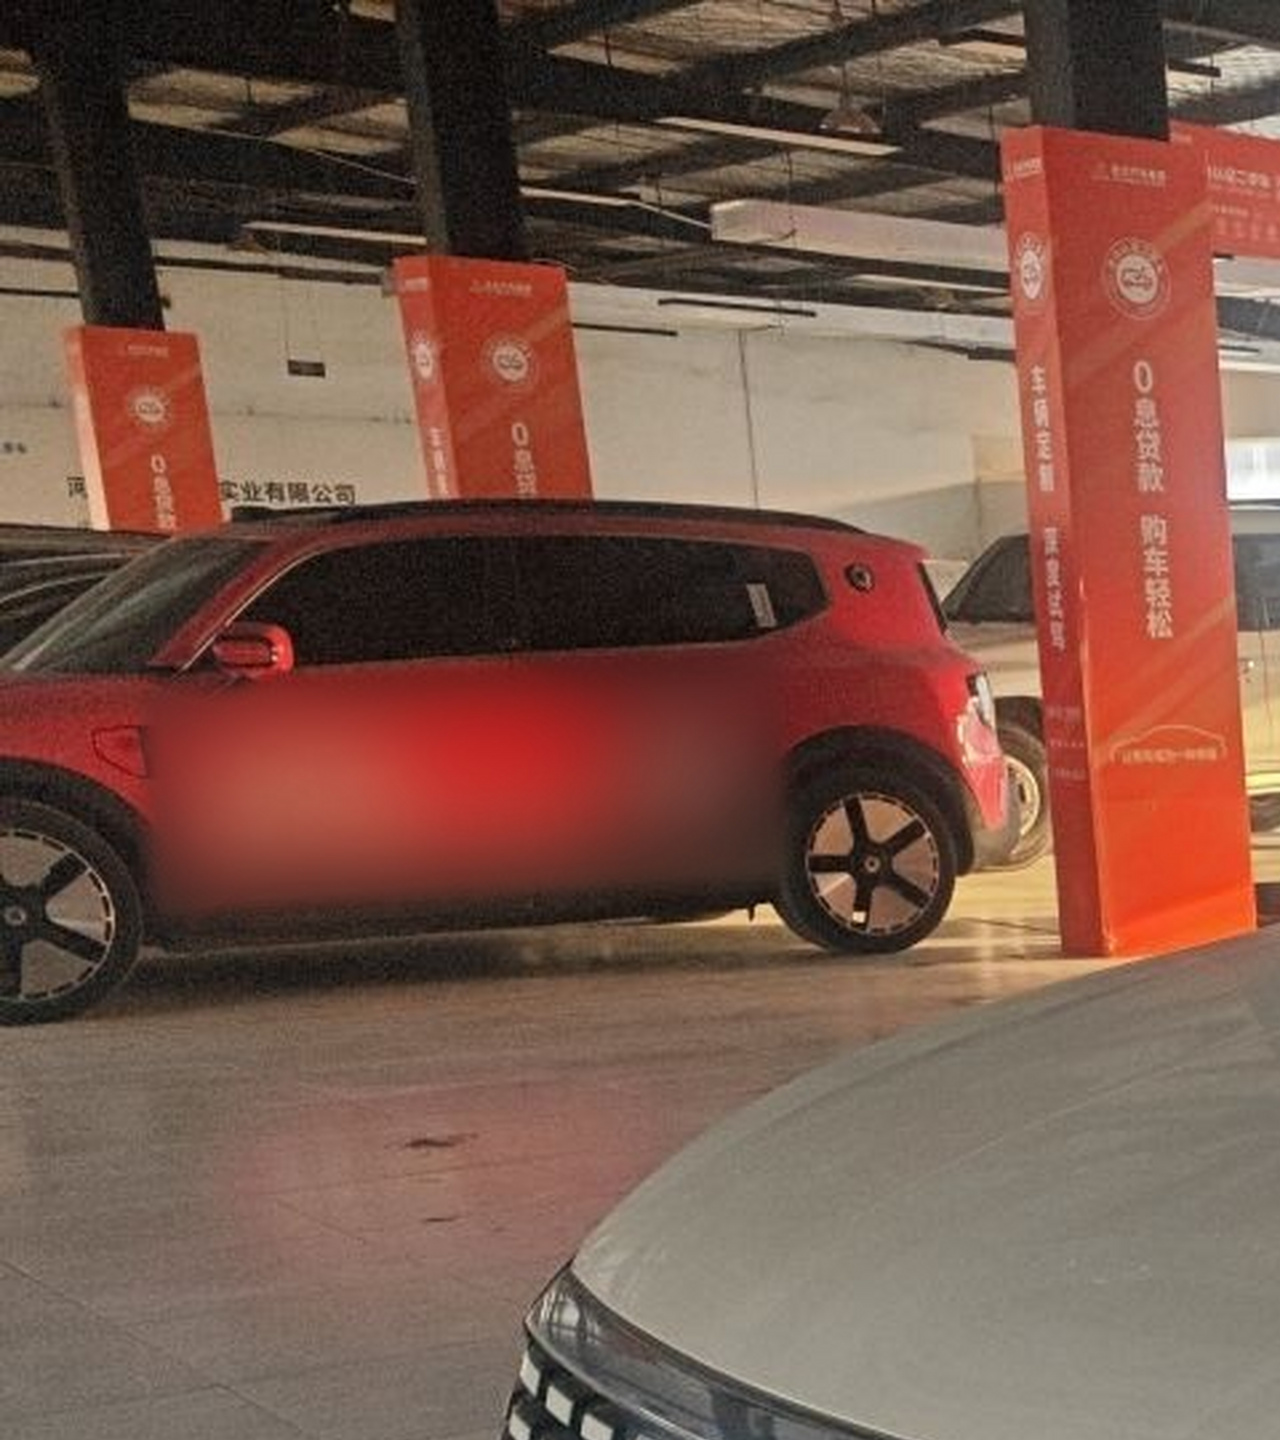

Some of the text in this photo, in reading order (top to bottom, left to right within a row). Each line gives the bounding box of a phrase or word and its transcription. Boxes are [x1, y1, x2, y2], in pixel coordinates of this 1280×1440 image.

[1133, 360, 1172, 640] 0息贷款 购车轻松
